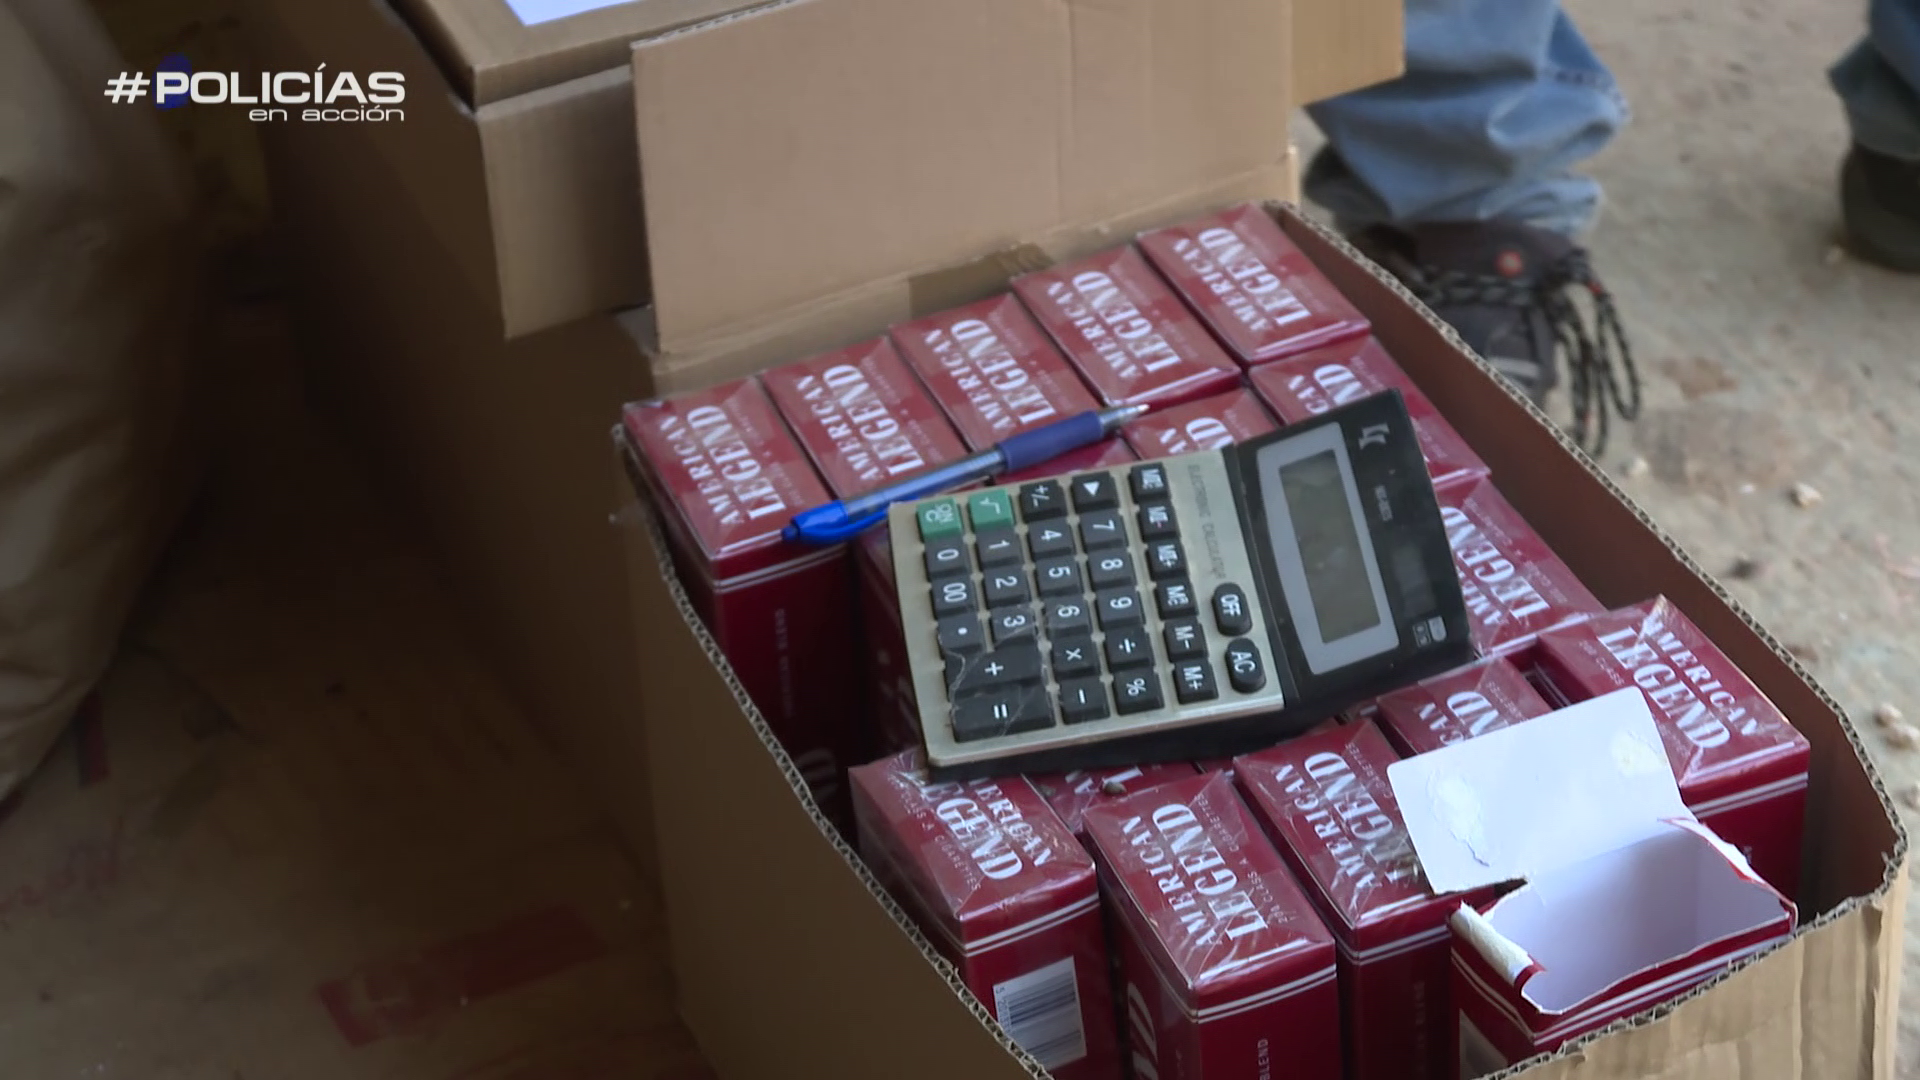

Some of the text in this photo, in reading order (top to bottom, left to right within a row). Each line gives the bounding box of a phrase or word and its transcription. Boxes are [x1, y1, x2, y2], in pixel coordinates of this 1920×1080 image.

[1071, 270, 1182, 373] LEGEND
[1173, 237, 1270, 332] AMERICAN
[1197, 227, 1313, 327] LEGEND
[951, 318, 1056, 425] LEGEND
[1046, 280, 1143, 380] AMERICAN
[796, 375, 884, 481] AMERICAN
[822, 363, 925, 476] LEGEND
[924, 328, 1016, 431] AMERICAN
[659, 415, 743, 526] AMERICAN
[687, 404, 787, 521] LEGEND
[989, 539, 1010, 550] 1
[1041, 528, 1062, 541] 4
[1049, 566, 1071, 579] 5
[1093, 519, 1115, 532] 7
[1101, 558, 1123, 571] 8
[943, 582, 968, 603] 00
[995, 576, 1018, 589] 2
[1003, 615, 1026, 628] 3
[1058, 605, 1080, 618] 6
[1110, 597, 1133, 610] 9
[1221, 593, 1242, 617] OFF
[1231, 650, 1255, 674] AC
[1596, 626, 1731, 748] LEGEND
[1645, 616, 1758, 736] AMERICAN
[1152, 803, 1268, 942] LEGEND
[1275, 764, 1383, 888] AMERICAN
[1122, 816, 1222, 946] AMERICAN
[1247, 871, 1273, 903] CLASS
